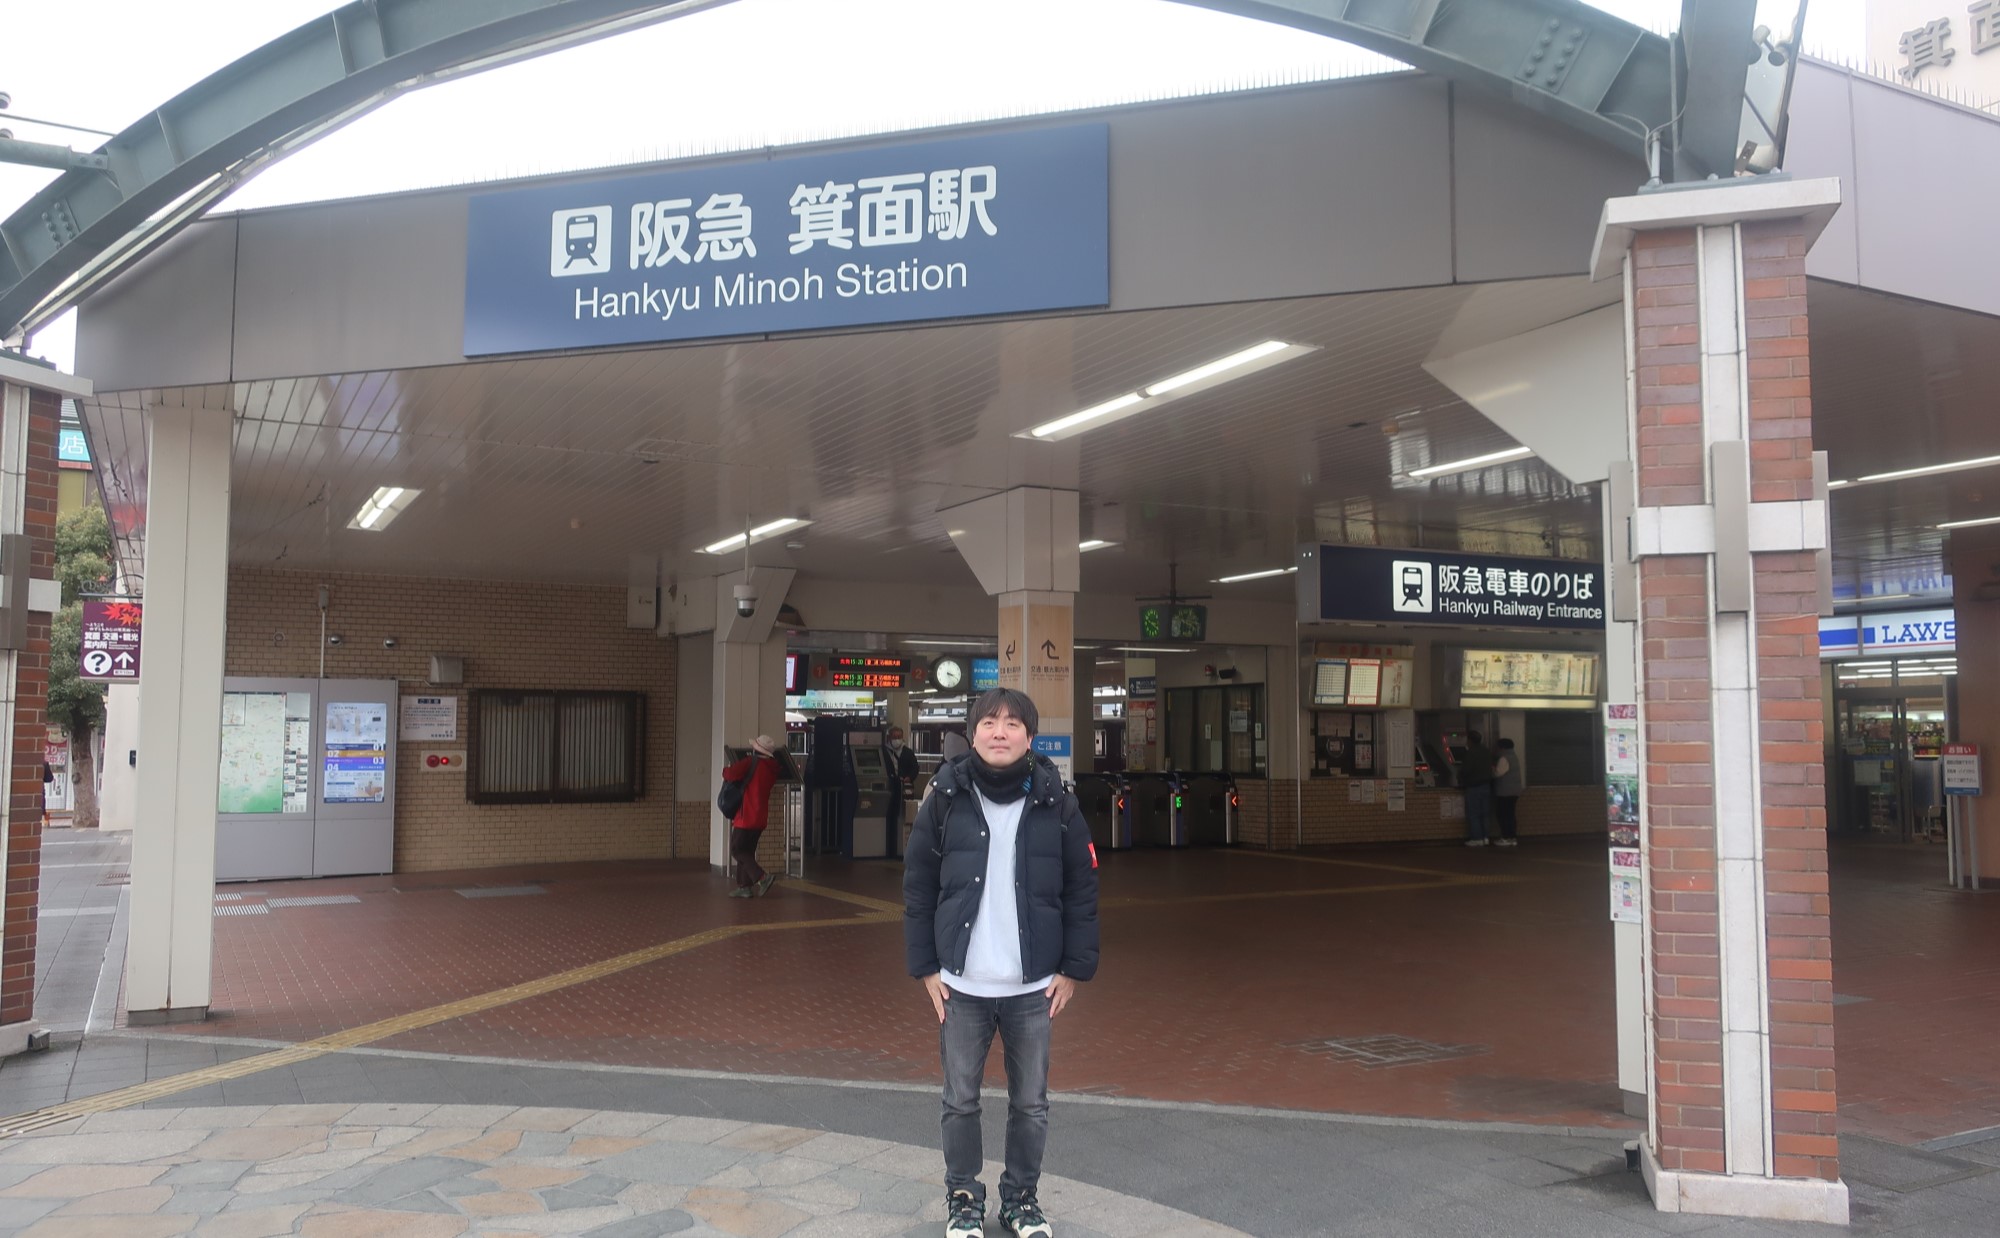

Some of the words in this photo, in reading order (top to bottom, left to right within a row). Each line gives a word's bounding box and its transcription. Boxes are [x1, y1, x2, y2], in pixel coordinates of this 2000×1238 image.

[629, 192, 758, 271] 阪急
[787, 165, 999, 256] 箕面駅
[574, 281, 701, 321] Hankyu
[714, 267, 824, 308] Minoh
[835, 258, 968, 298] Station
[1438, 564, 1595, 600] 阪急電車のりば
[1438, 597, 1490, 618] Hankyu
[1493, 599, 1544, 621] Railway
[1547, 602, 1603, 620] Entrance
[1037, 741, 1062, 751] ご注意
[327, 763, 339, 771] 04
[372, 757, 385, 765] 03
